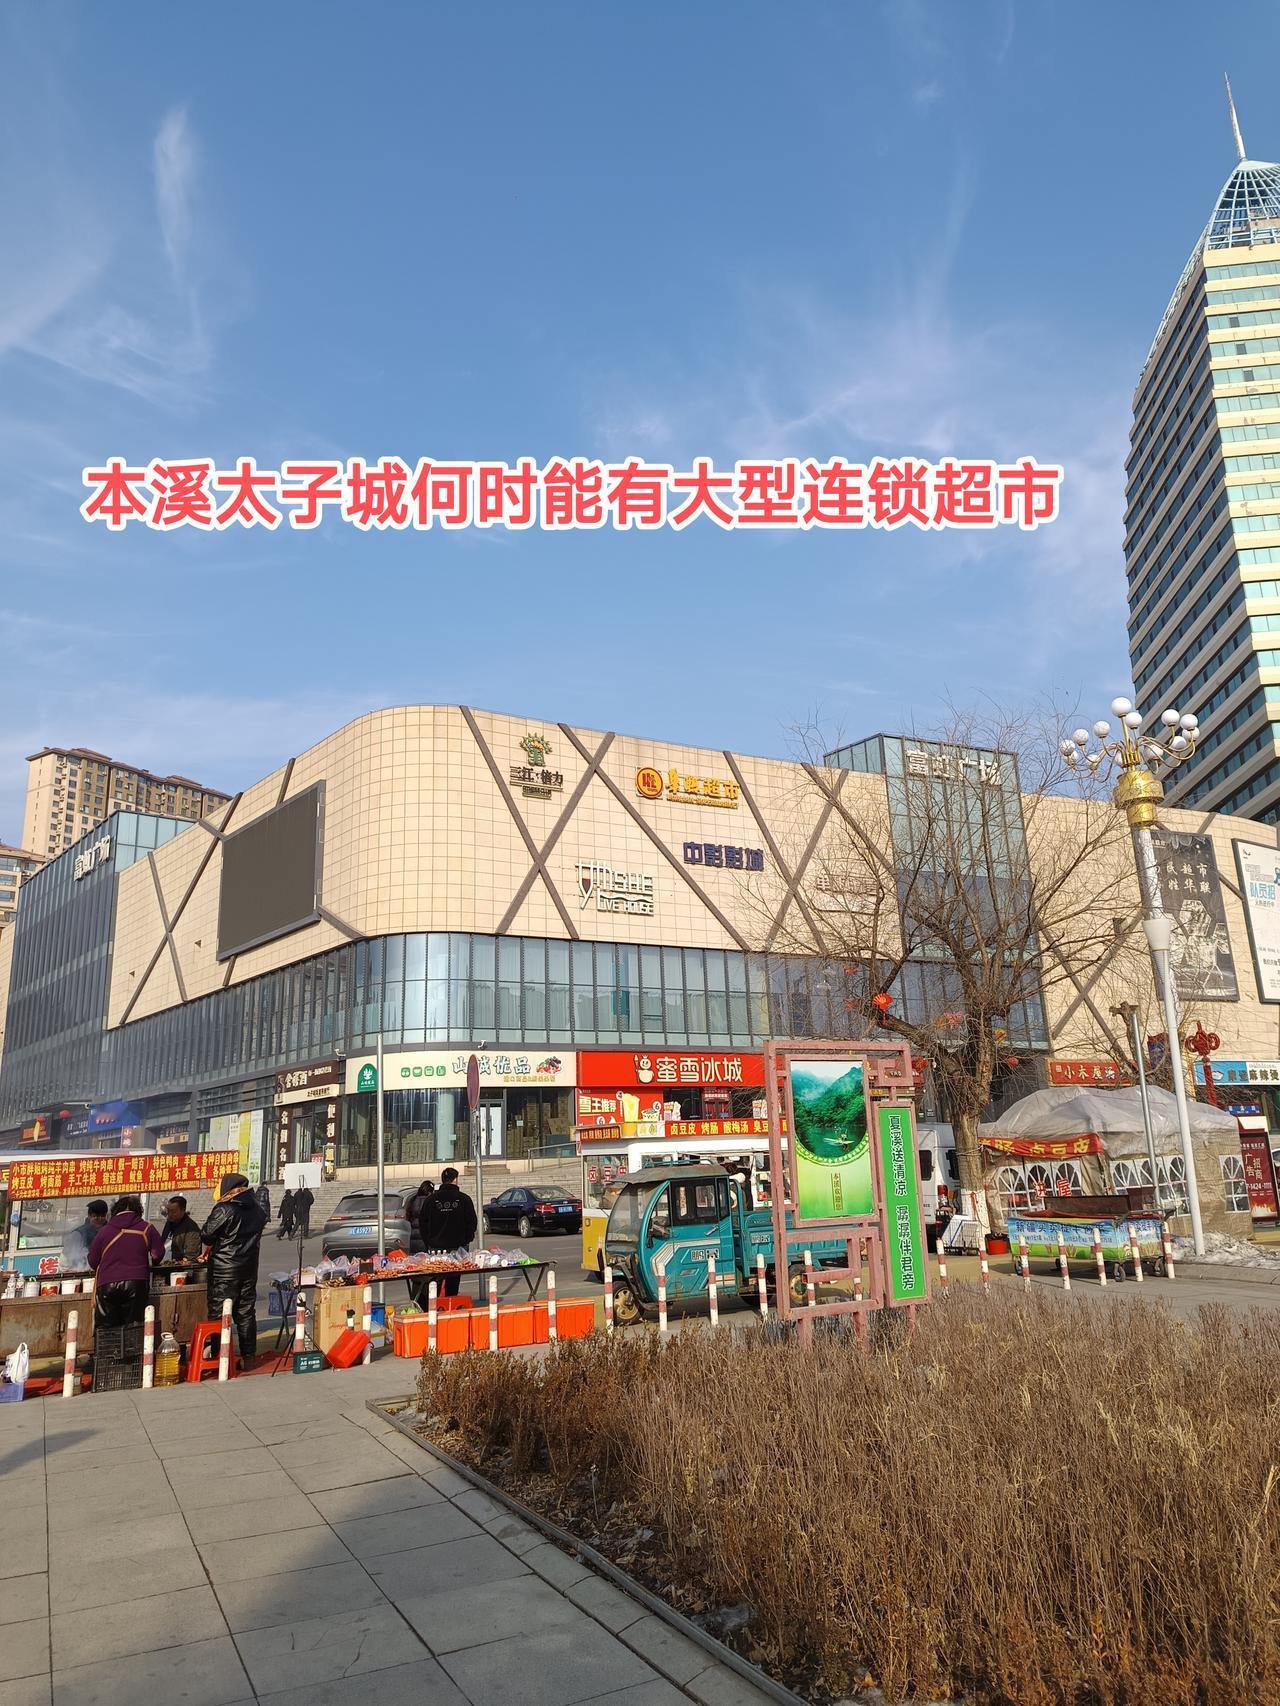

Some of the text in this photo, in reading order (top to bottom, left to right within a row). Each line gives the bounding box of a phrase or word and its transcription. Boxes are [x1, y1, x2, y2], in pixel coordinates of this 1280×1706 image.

[656, 1056, 744, 1084] 蜜雪冰城
[579, 1095, 617, 1114] 雪王推荐
[670, 1122, 697, 1136] 卤豆皮
[701, 1121, 719, 1135] 烤肠
[723, 1120, 749, 1134] 酸梅汤
[889, 1115, 915, 1290] 夏溪送清凉 潺潺伴君旁
[40, 1257, 60, 1274] 烤
